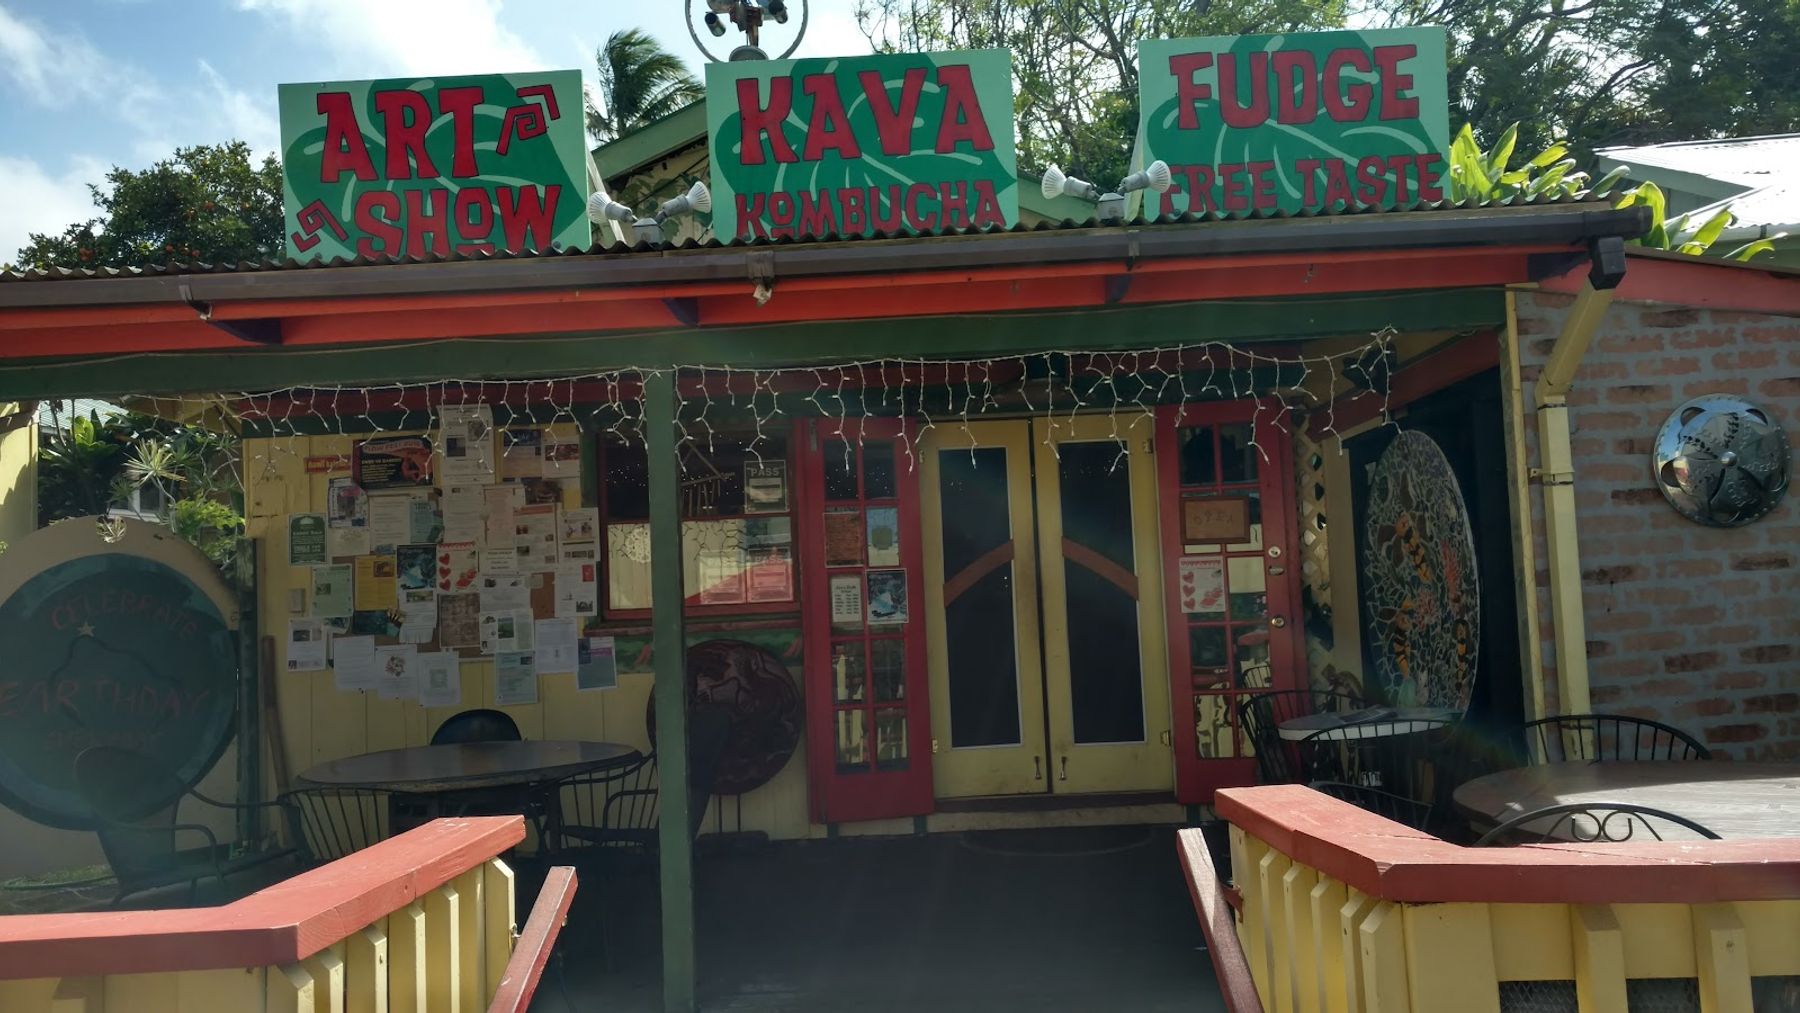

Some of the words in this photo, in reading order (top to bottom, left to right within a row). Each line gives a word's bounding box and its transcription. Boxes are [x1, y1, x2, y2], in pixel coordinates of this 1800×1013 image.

[736, 64, 995, 166] KAVA
[1169, 44, 1420, 130] FUDGE
[317, 86, 484, 184] ART
[735, 180, 1007, 239] KOMBUCHA
[1159, 160, 1278, 215] FREE
[1296, 153, 1444, 208] TASTE
[354, 184, 562, 259] SHOW
[750, 467, 780, 477] PASS
[754, 554, 784, 565] PASS
